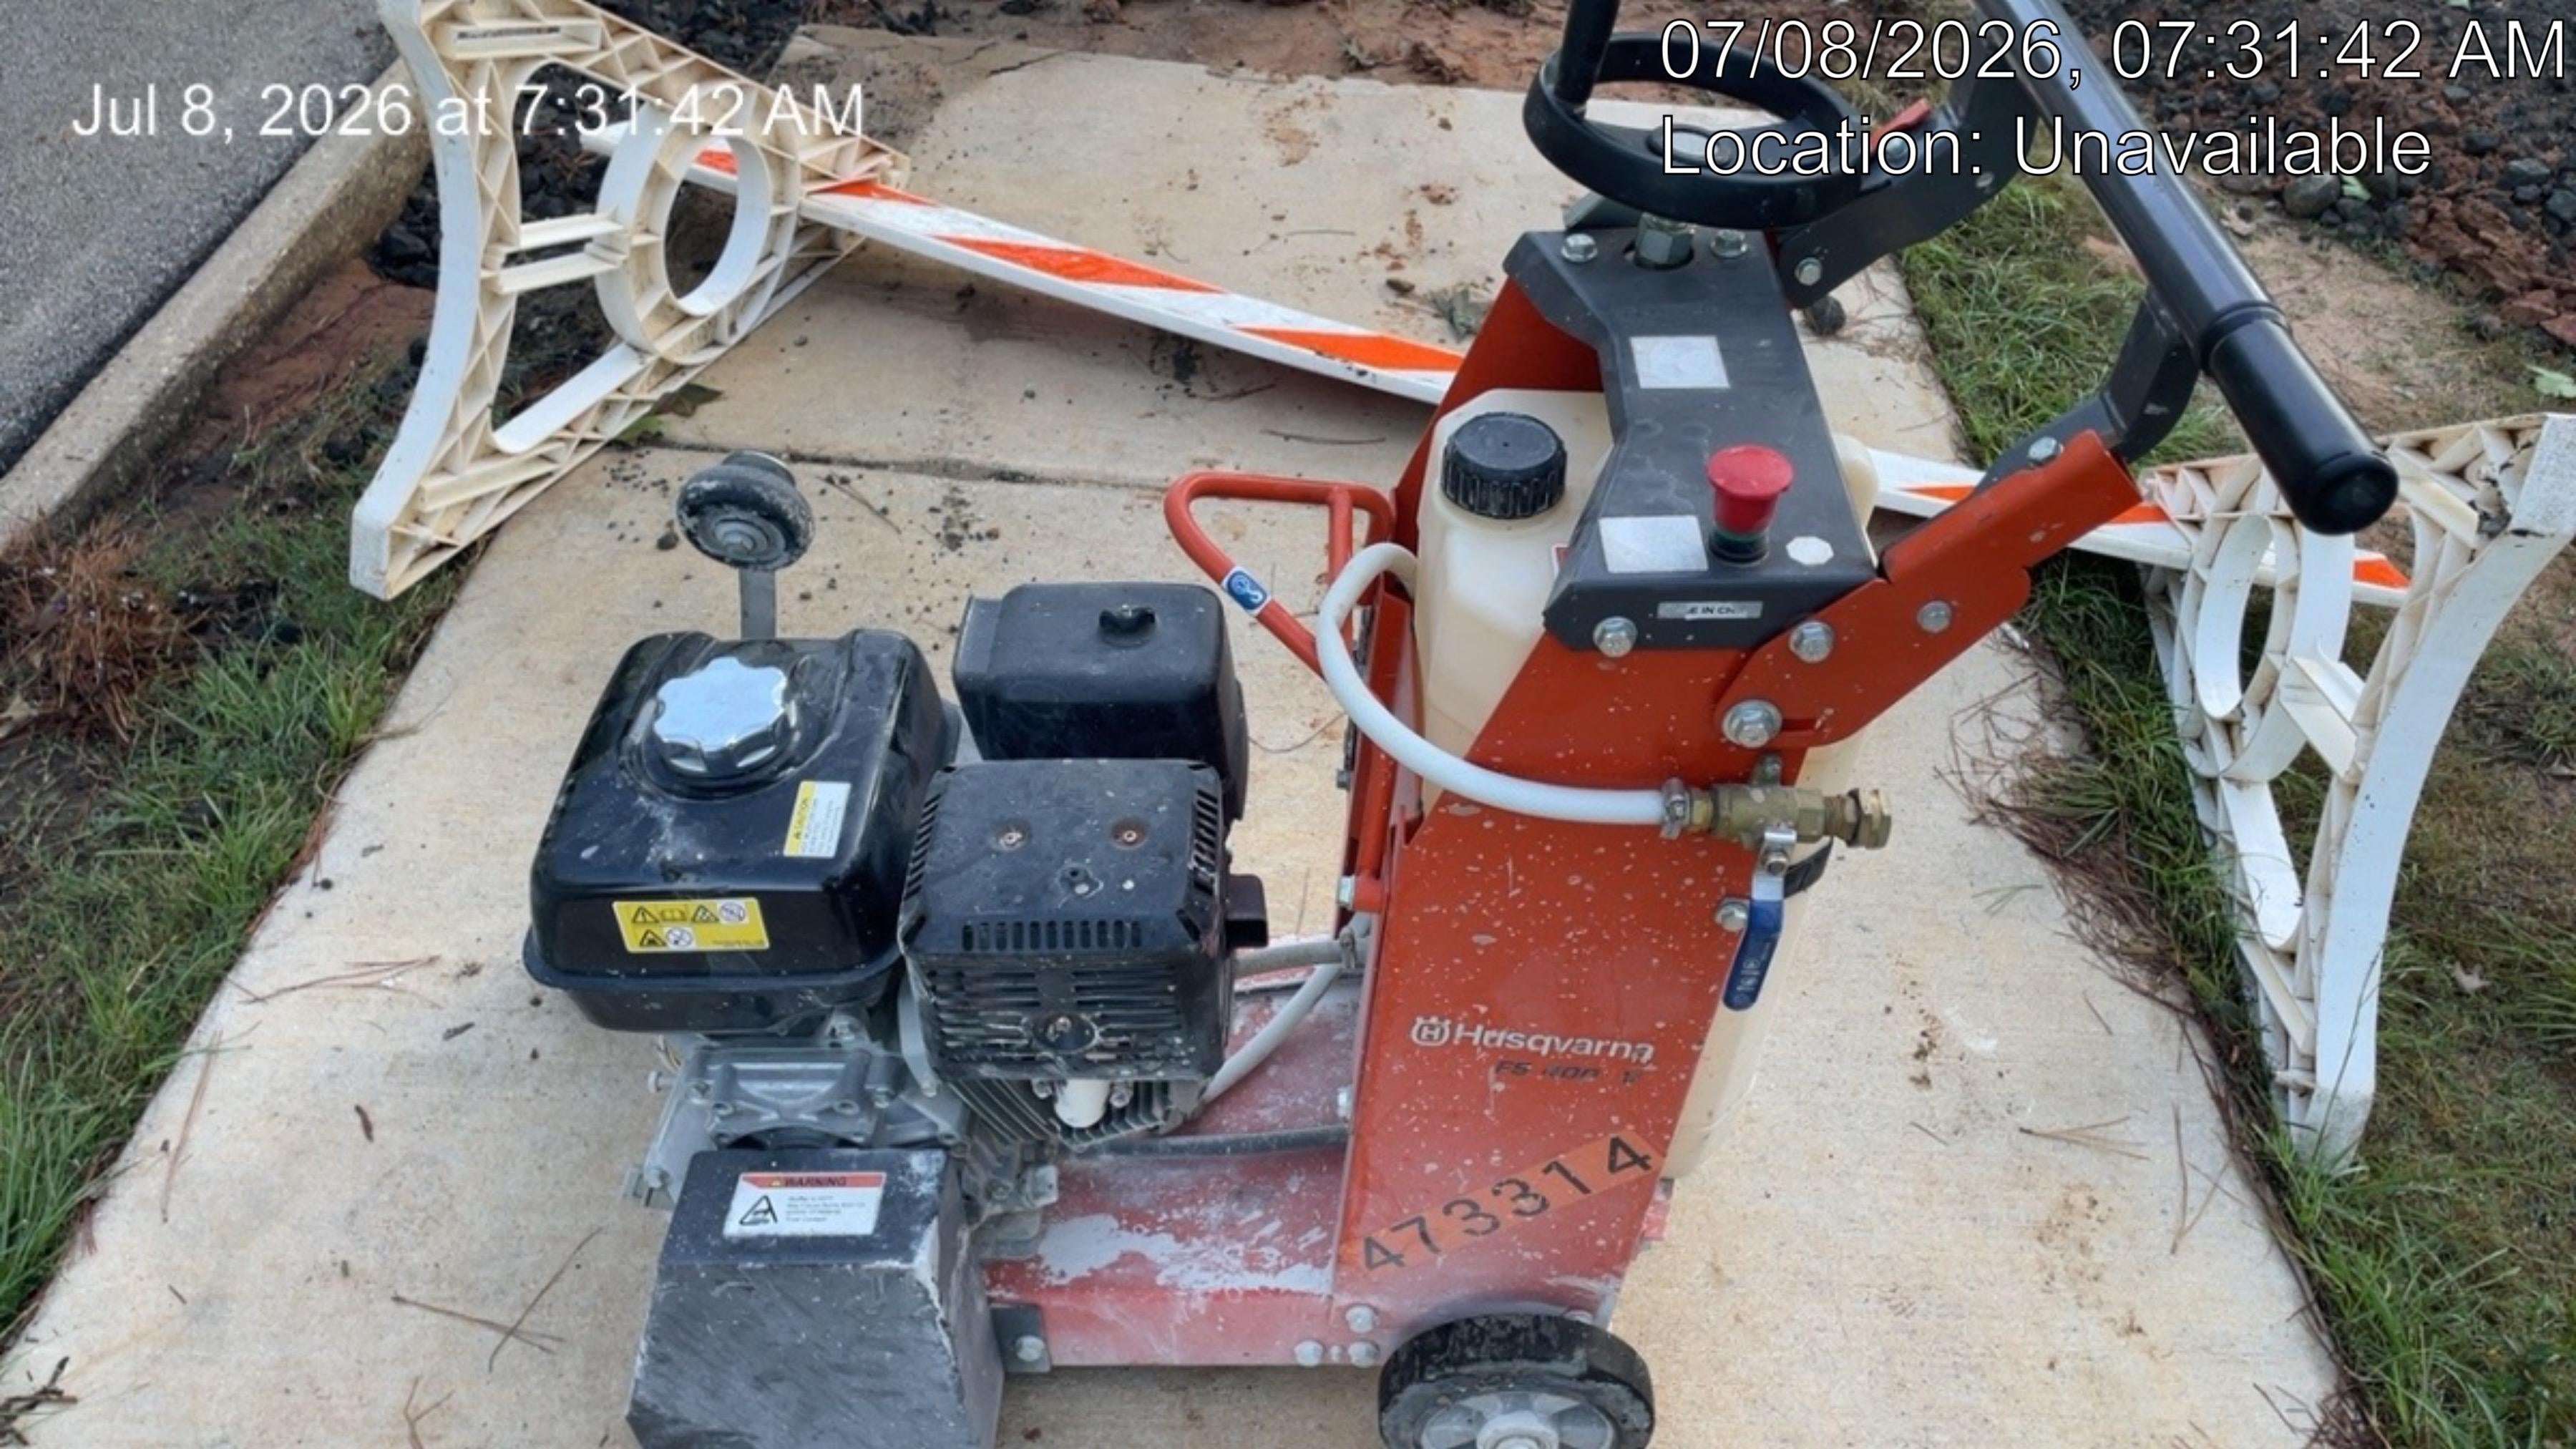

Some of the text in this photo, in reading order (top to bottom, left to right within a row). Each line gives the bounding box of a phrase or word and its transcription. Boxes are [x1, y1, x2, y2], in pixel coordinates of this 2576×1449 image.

[1453, 1023, 1655, 1064] Husqvarna
[785, 1176, 847, 1187] WARNING
[1364, 1135, 1653, 1272] 473314
